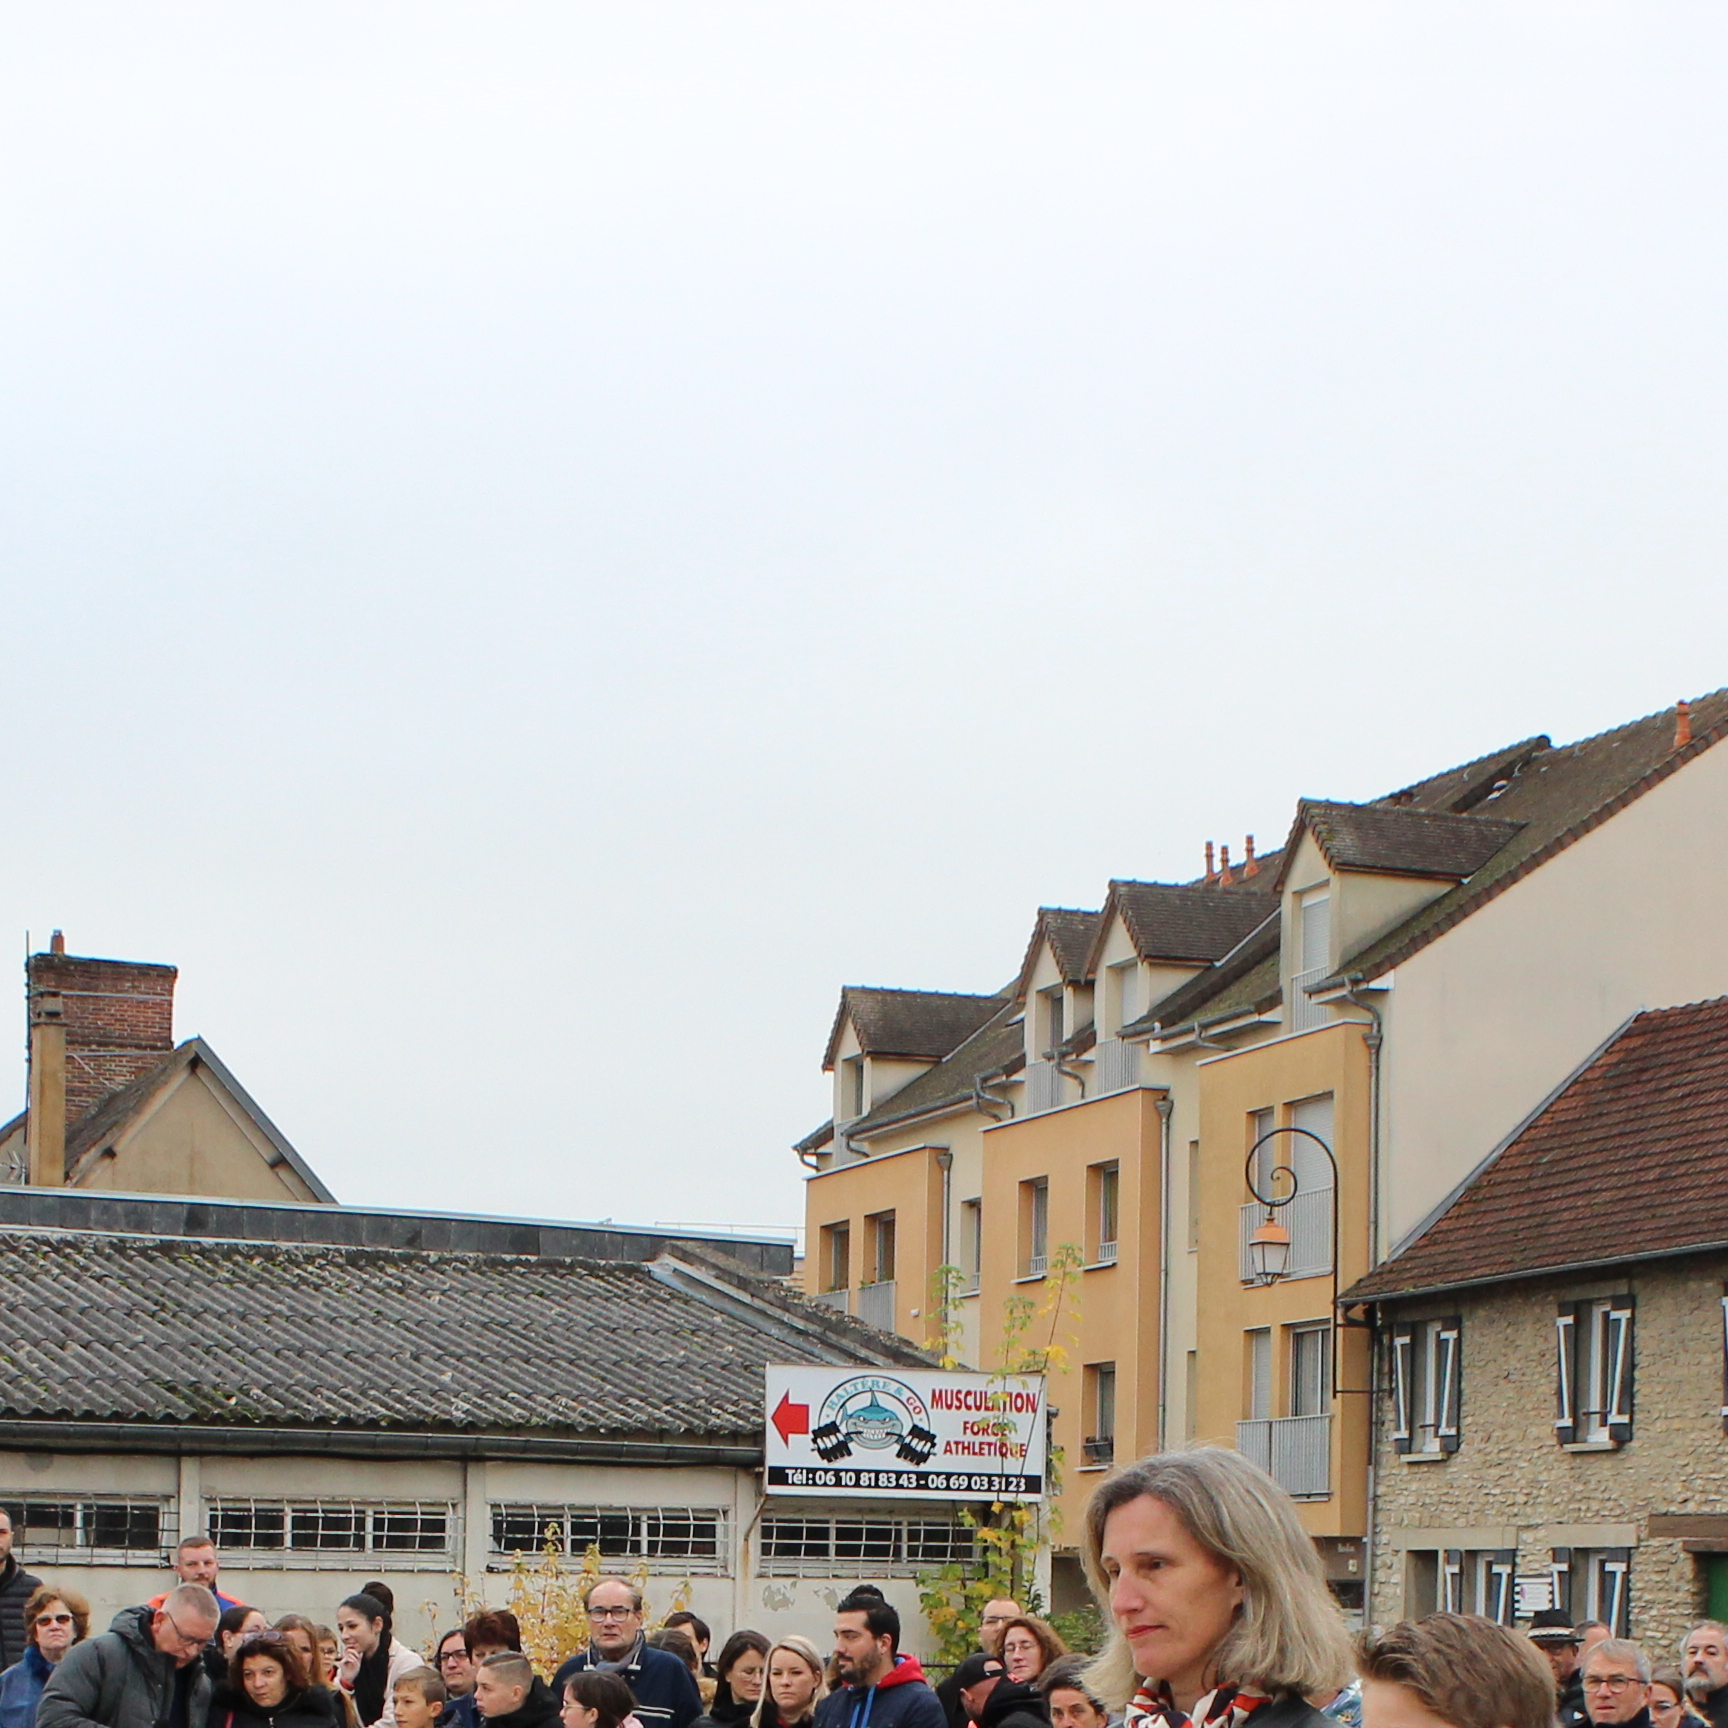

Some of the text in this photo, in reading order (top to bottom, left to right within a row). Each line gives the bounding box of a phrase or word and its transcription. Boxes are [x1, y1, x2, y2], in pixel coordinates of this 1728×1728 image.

[906, 1396, 923, 1415] GO
[943, 1440, 1028, 1460] ATHLETIQUE
[815, 1470, 836, 1486] 06
[839, 1471, 856, 1486] 10
[859, 1472, 875, 1487] 81
[878, 1472, 896, 1488] 83
[898, 1473, 917, 1488] 43
[927, 1474, 947, 1489] 06
[949, 1475, 969, 1490] 69
[971, 1475, 989, 1490] 03
[990, 1476, 1006, 1491] 31
[1008, 1476, 1026, 1492] 23
